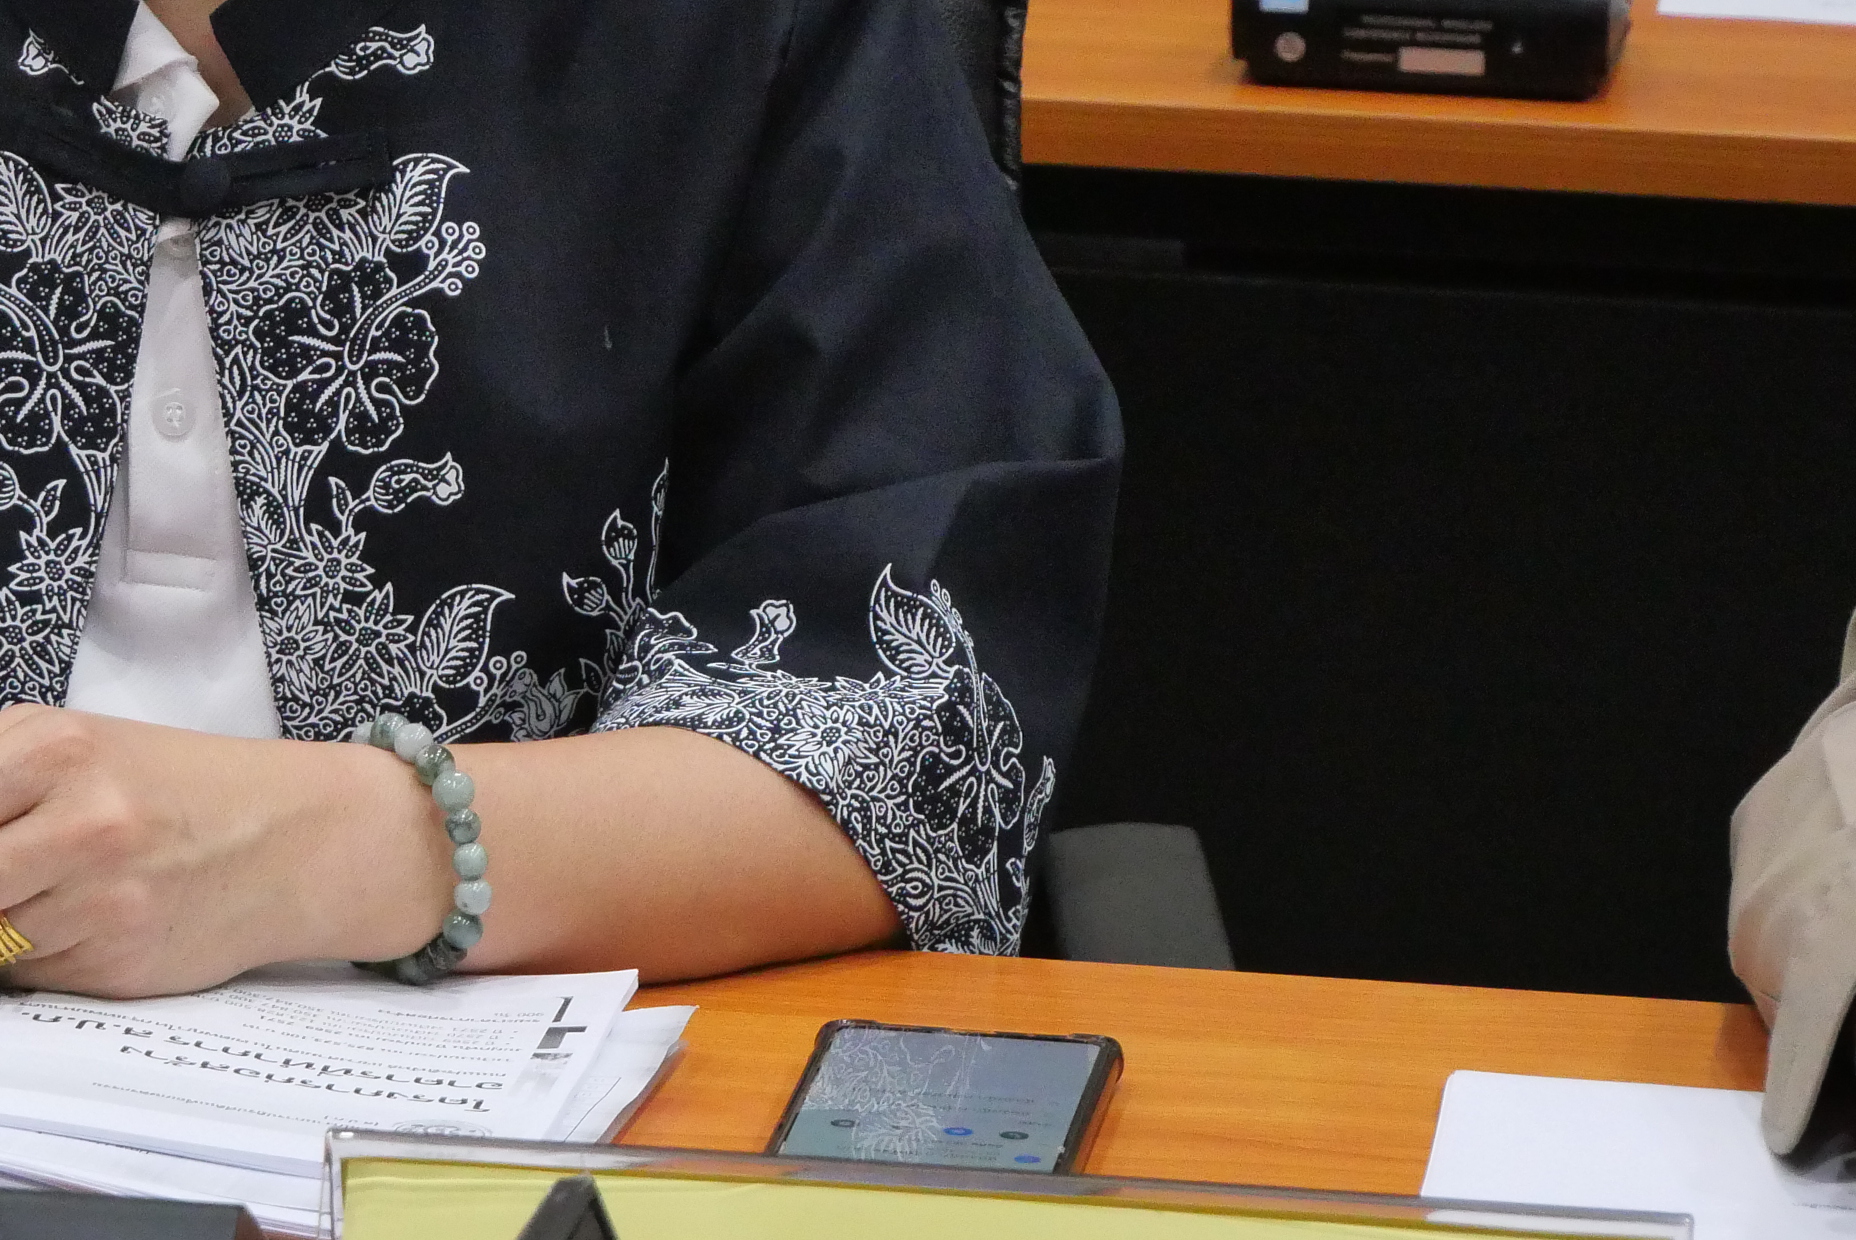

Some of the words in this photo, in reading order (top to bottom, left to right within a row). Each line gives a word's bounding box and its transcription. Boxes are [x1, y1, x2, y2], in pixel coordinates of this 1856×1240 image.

[22, 1011, 154, 1038] ส.ป.ก.
[120, 1045, 491, 1112] โครงการก่อสร้าง
[164, 1035, 503, 1090] อาคารที่ทำการ
